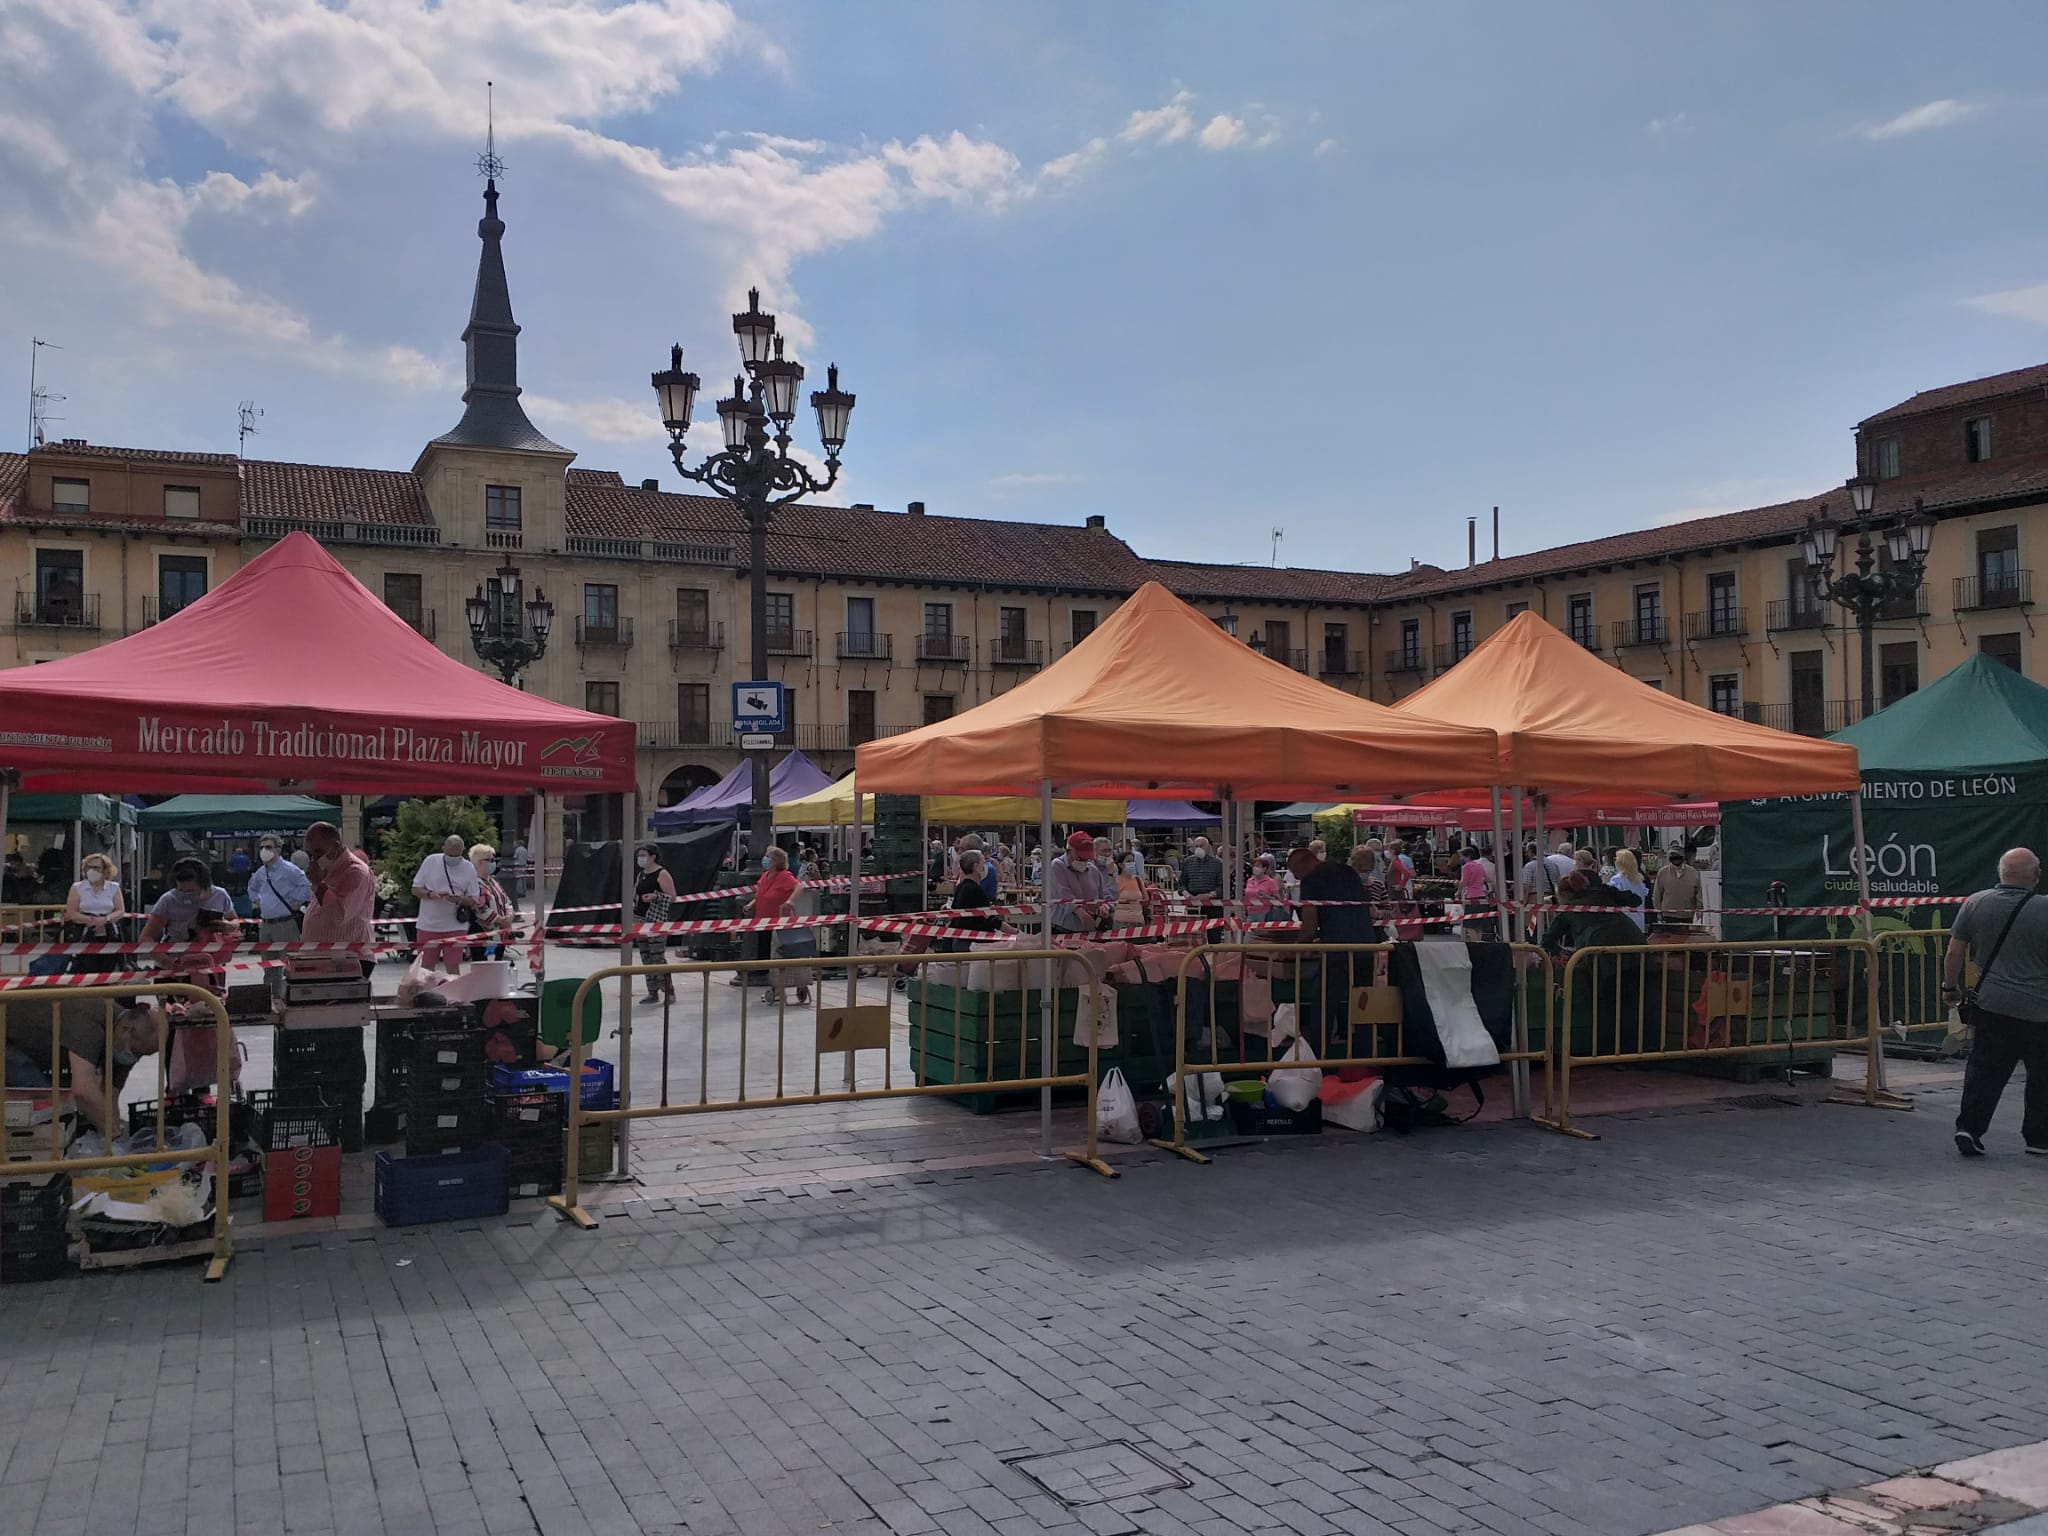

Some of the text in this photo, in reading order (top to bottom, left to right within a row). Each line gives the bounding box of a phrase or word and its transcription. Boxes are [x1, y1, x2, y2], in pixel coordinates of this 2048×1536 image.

[137, 716, 528, 771] Mercado Tradicional Plaza Mayor
[1930, 780, 1956, 798] DE
[1961, 773, 2017, 797] LEÓN
[1822, 832, 1937, 877] León
[1824, 878, 1940, 894] ciuda saludable
